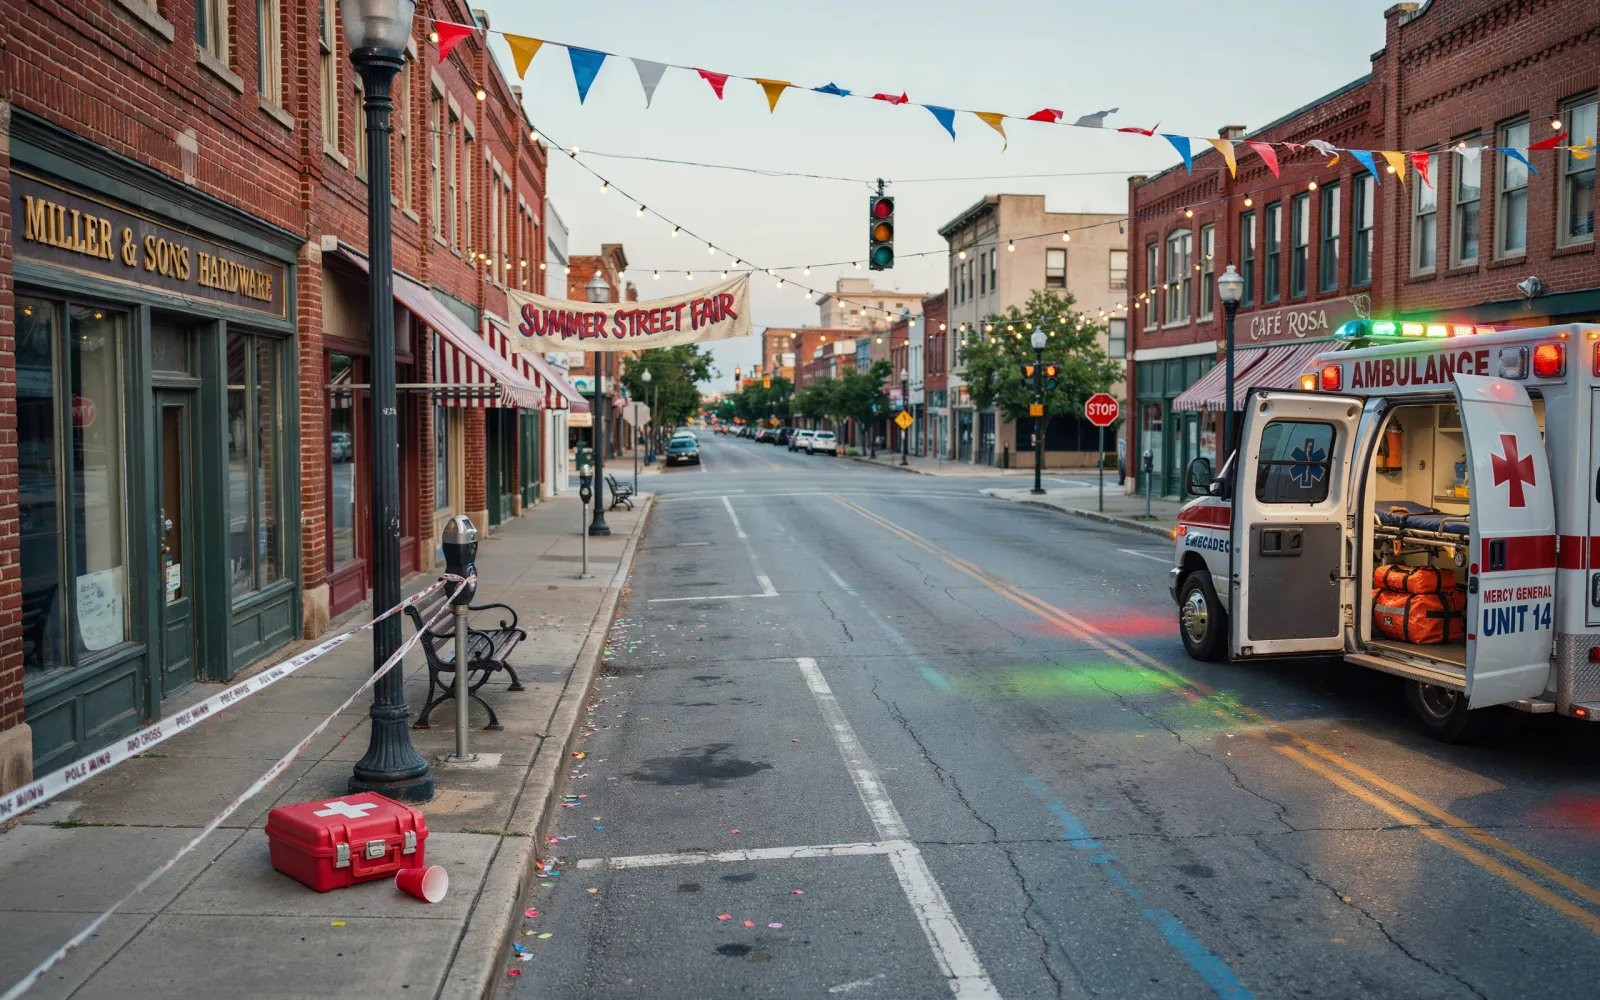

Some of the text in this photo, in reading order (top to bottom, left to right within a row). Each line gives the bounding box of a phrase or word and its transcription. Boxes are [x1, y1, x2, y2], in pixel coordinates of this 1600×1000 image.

[23, 195, 272, 302] MILLER & SONS HARDWARE
[518, 293, 738, 340] SUMMER STREET FAIR
[1250, 310, 1329, 340] CAFÉ ROSA
[1351, 350, 1490, 389] AMBULANCE
[1088, 402, 1117, 416] STOP
[1483, 585, 1552, 604] MERCY GENERAL
[1483, 602, 1552, 637] UNIT 14
